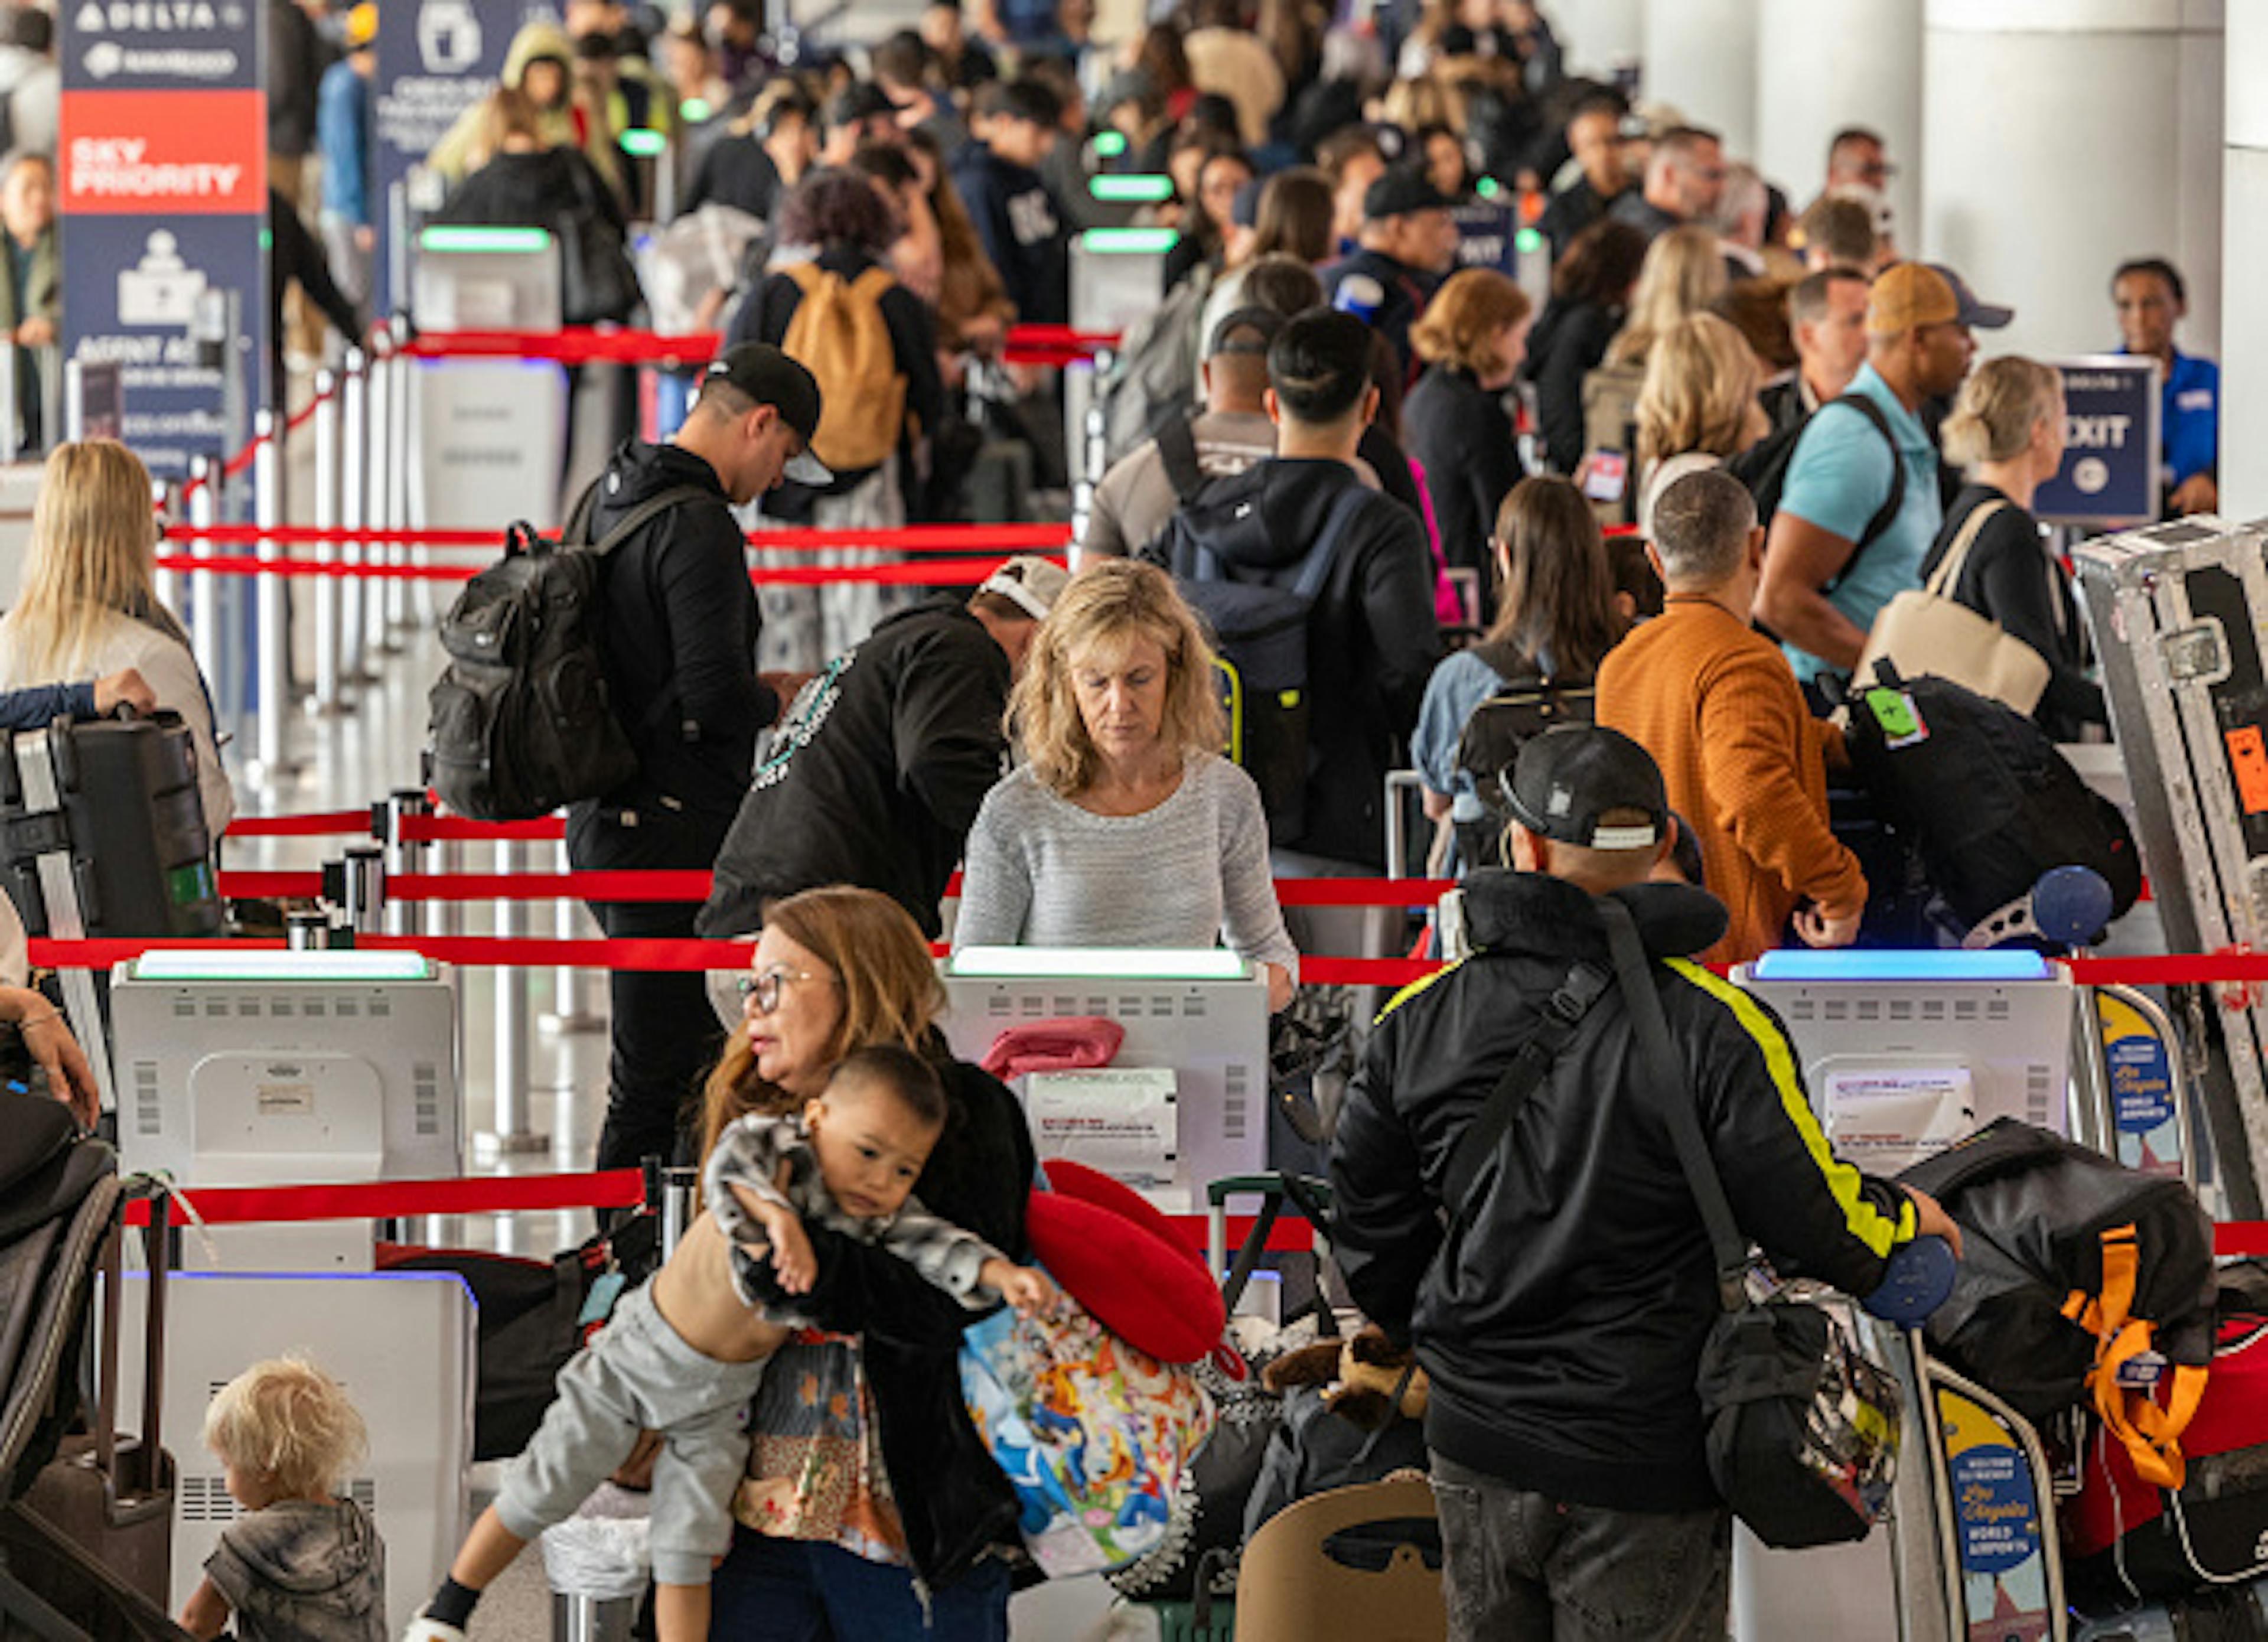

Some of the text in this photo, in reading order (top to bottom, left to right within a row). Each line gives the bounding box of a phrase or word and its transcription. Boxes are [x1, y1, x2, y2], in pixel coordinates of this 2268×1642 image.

[109, 2, 215, 30] DELTA
[72, 137, 146, 163] SKY
[72, 164, 241, 195] PRIORITY
[1969, 1526, 2013, 1540] WORLD
[1969, 1539, 2029, 1556] AIRPORTS
